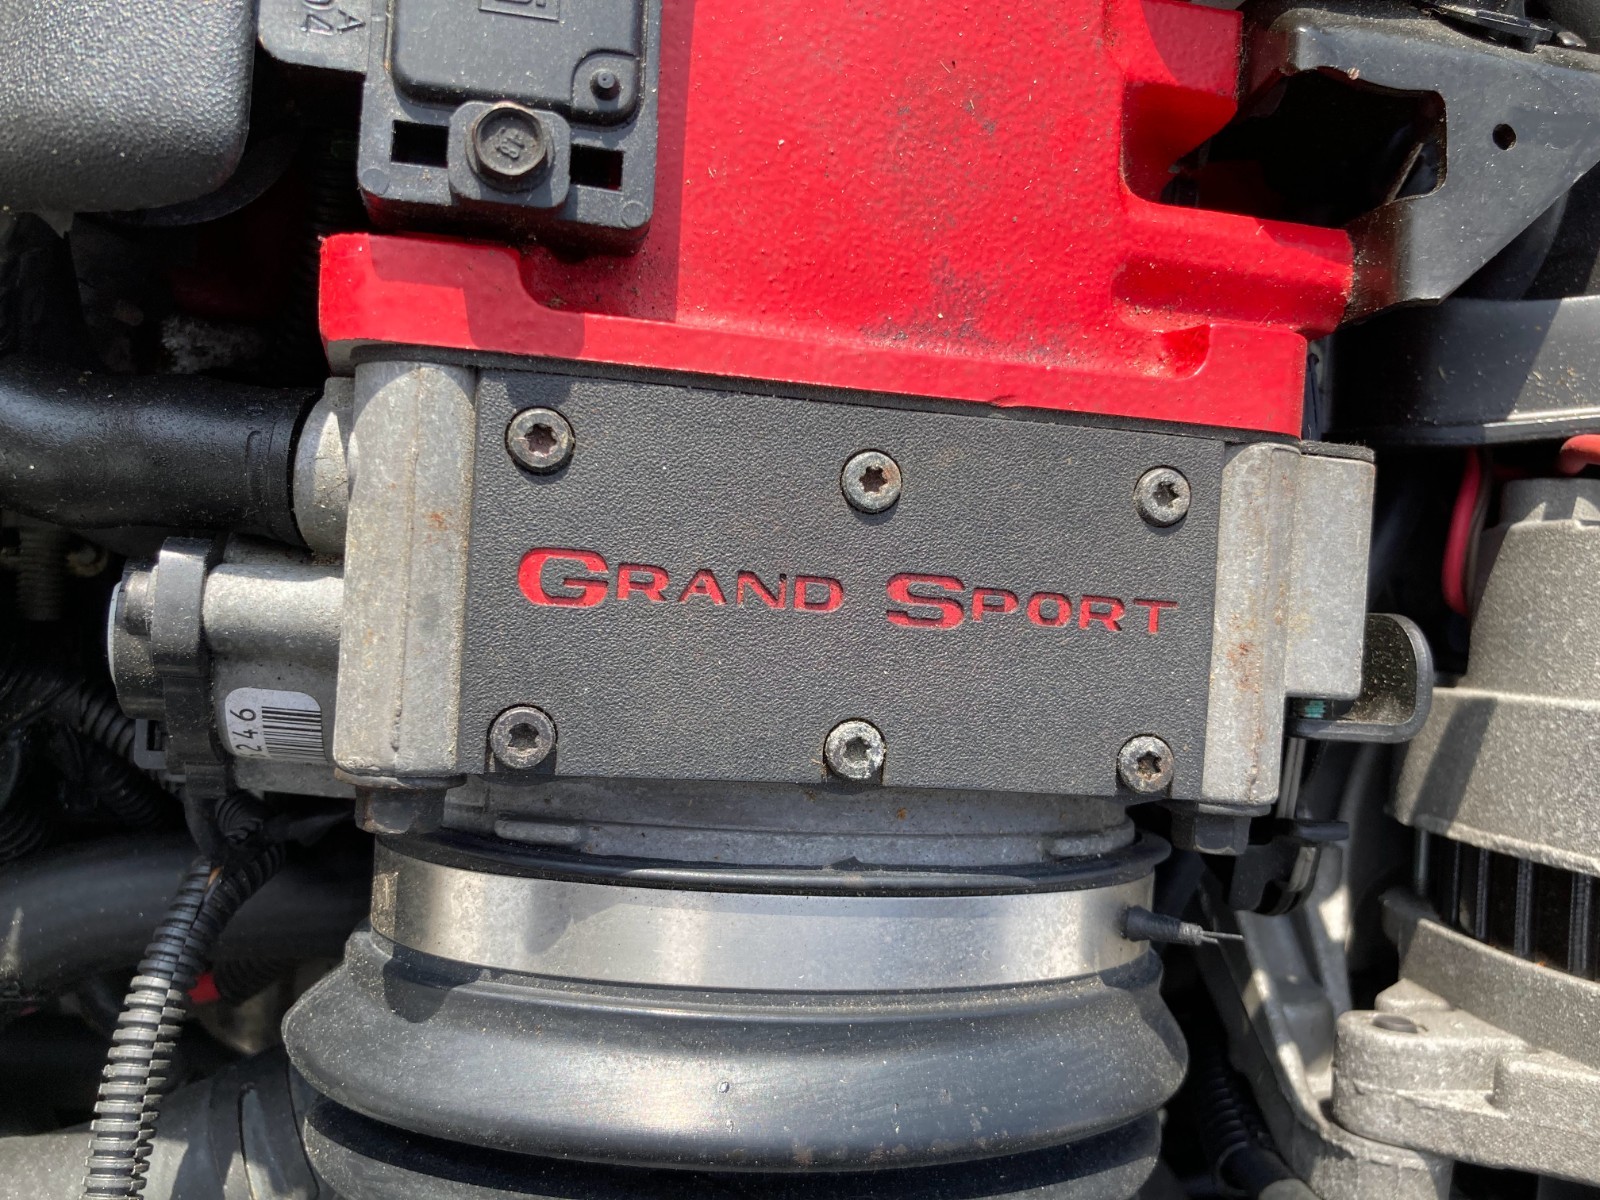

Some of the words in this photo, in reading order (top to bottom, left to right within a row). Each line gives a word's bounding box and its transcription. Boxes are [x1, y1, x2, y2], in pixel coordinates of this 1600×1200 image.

[517, 547, 844, 613] GRAND
[886, 572, 1178, 634] SPORT
[229, 708, 264, 757] 246
